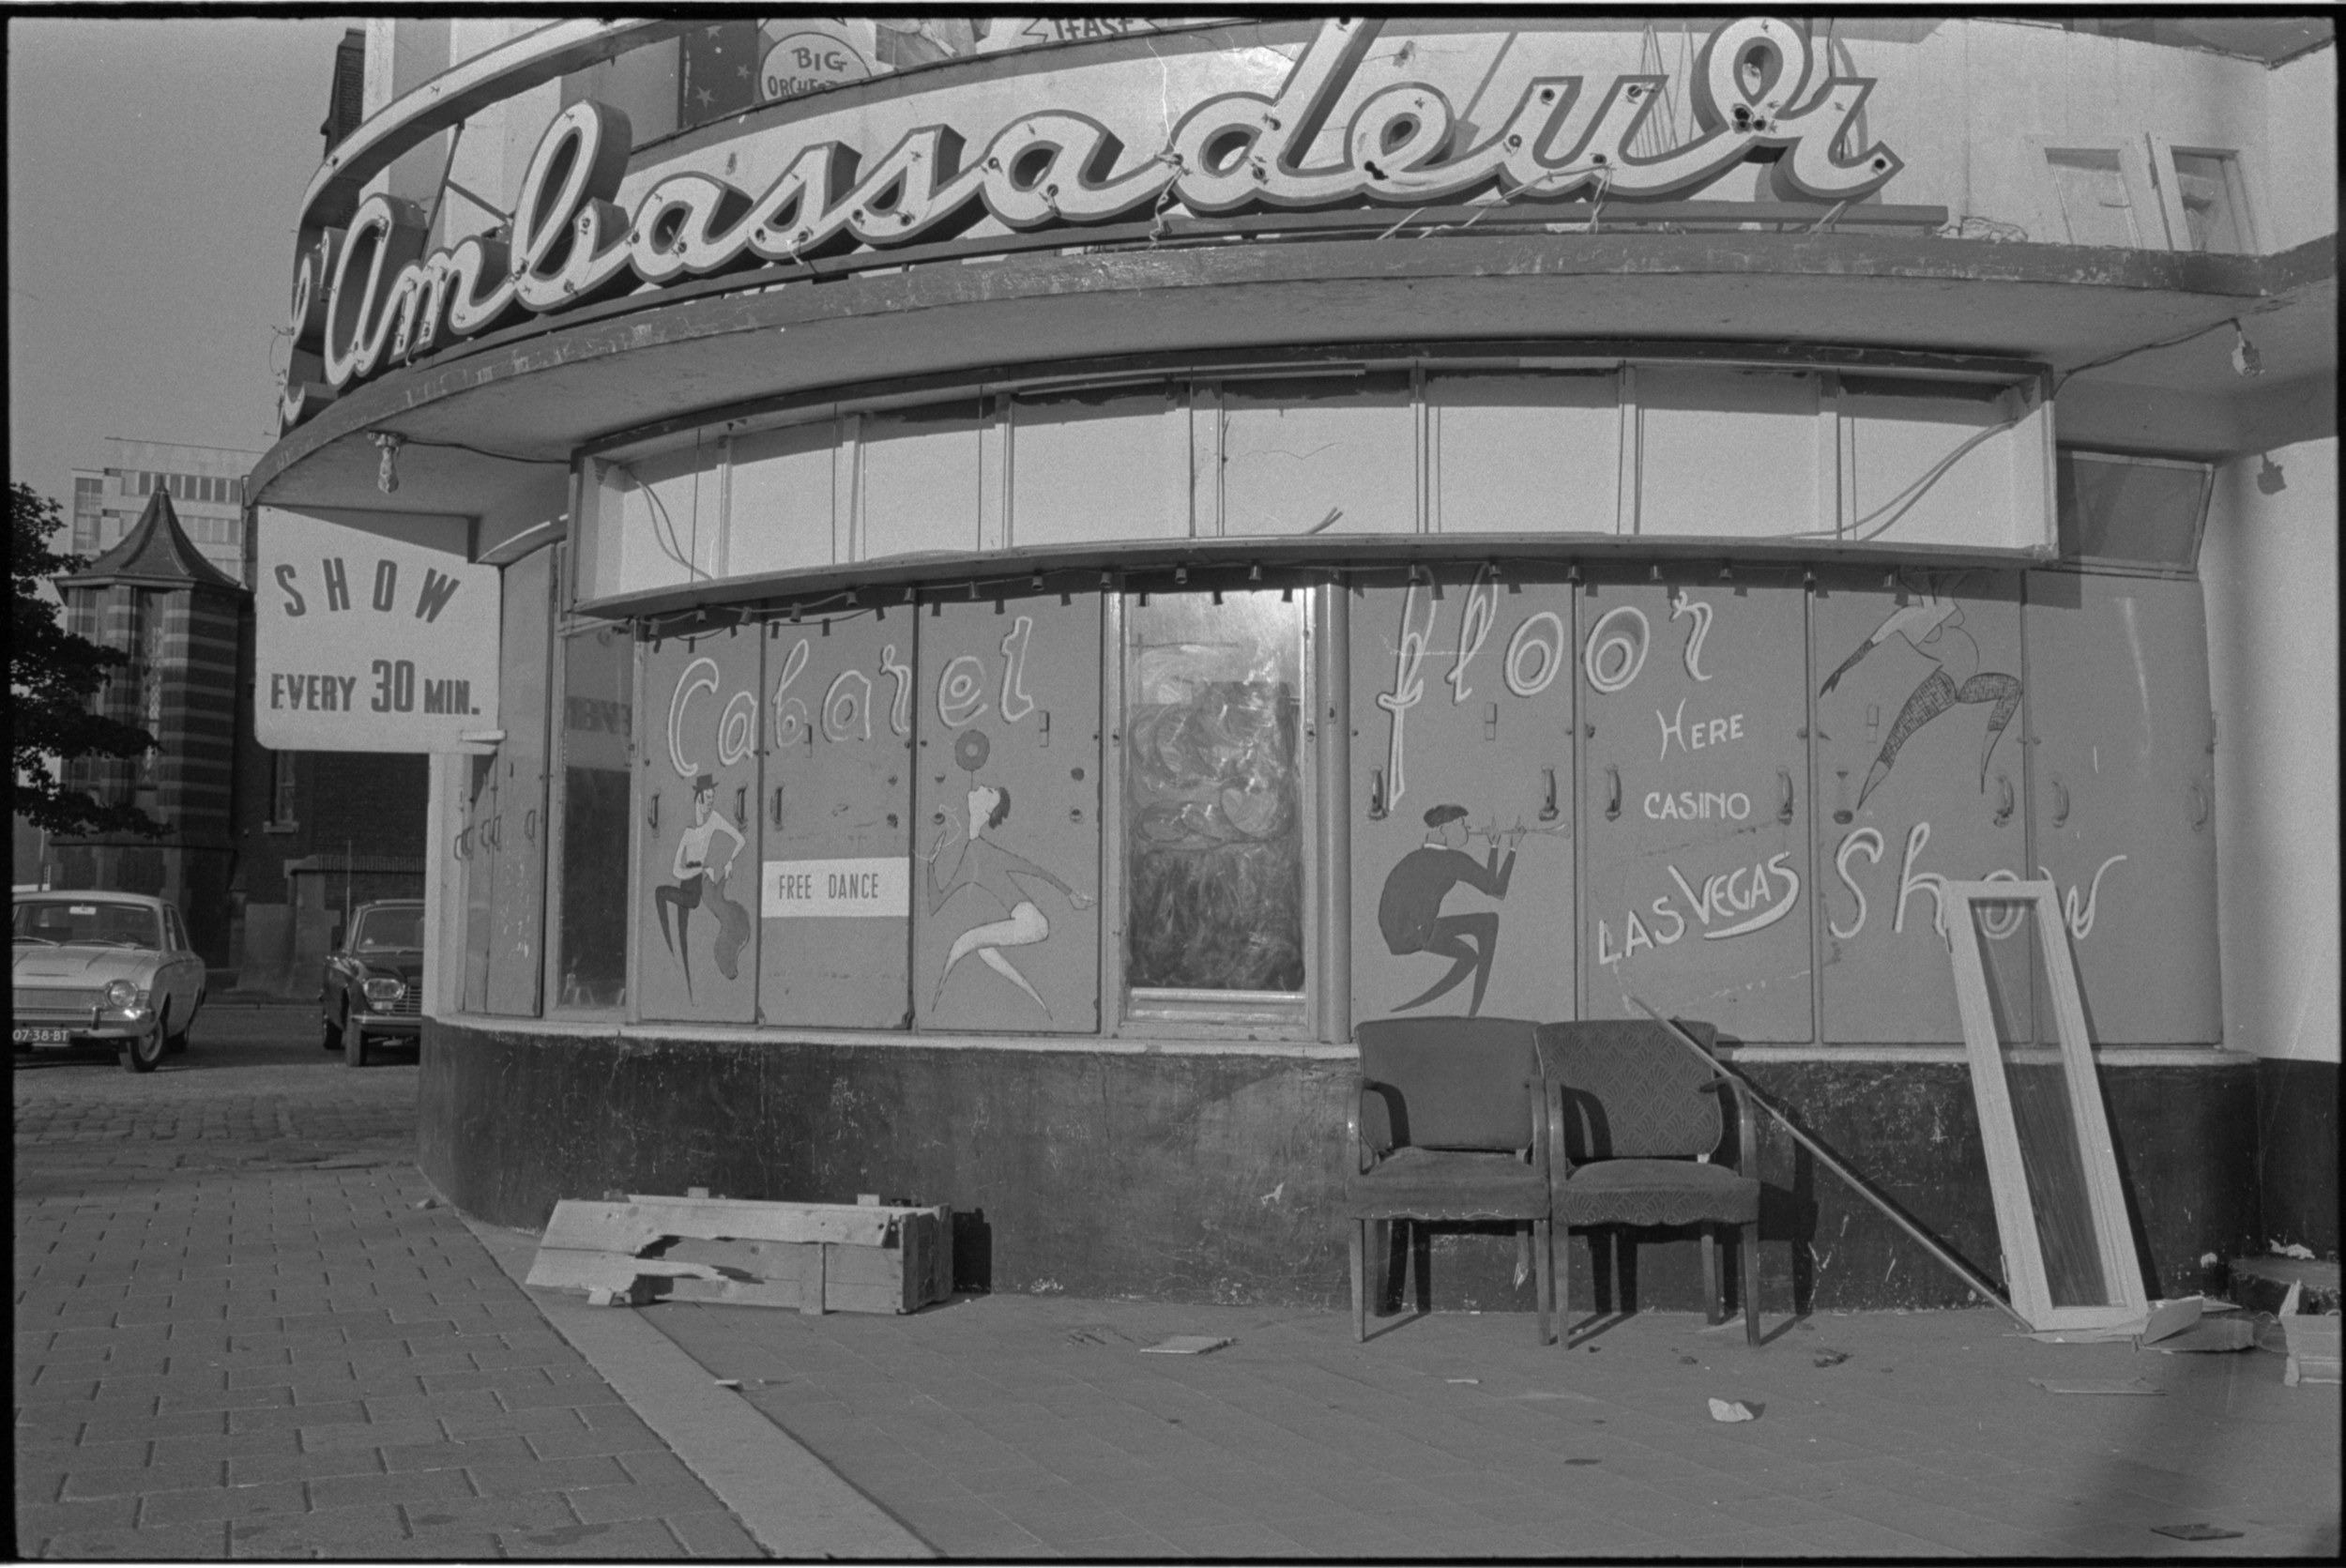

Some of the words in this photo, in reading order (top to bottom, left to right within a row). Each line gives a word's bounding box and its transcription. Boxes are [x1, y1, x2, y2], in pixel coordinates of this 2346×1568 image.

[791, 47, 847, 72] BIG
[274, 557, 461, 624] SHOW
[270, 673, 357, 711] EVERY
[371, 660, 415, 713] 30
[424, 678, 480, 715] MIN.
[668, 616, 1034, 777] Cabaret
[1656, 698, 1744, 761] HERE
[1644, 793, 1750, 819] CASINO
[779, 875, 812, 899] FREE
[829, 874, 878, 899] DANCE
[1599, 896, 1686, 965] LAS
[1668, 852, 1800, 939] VEGAS
